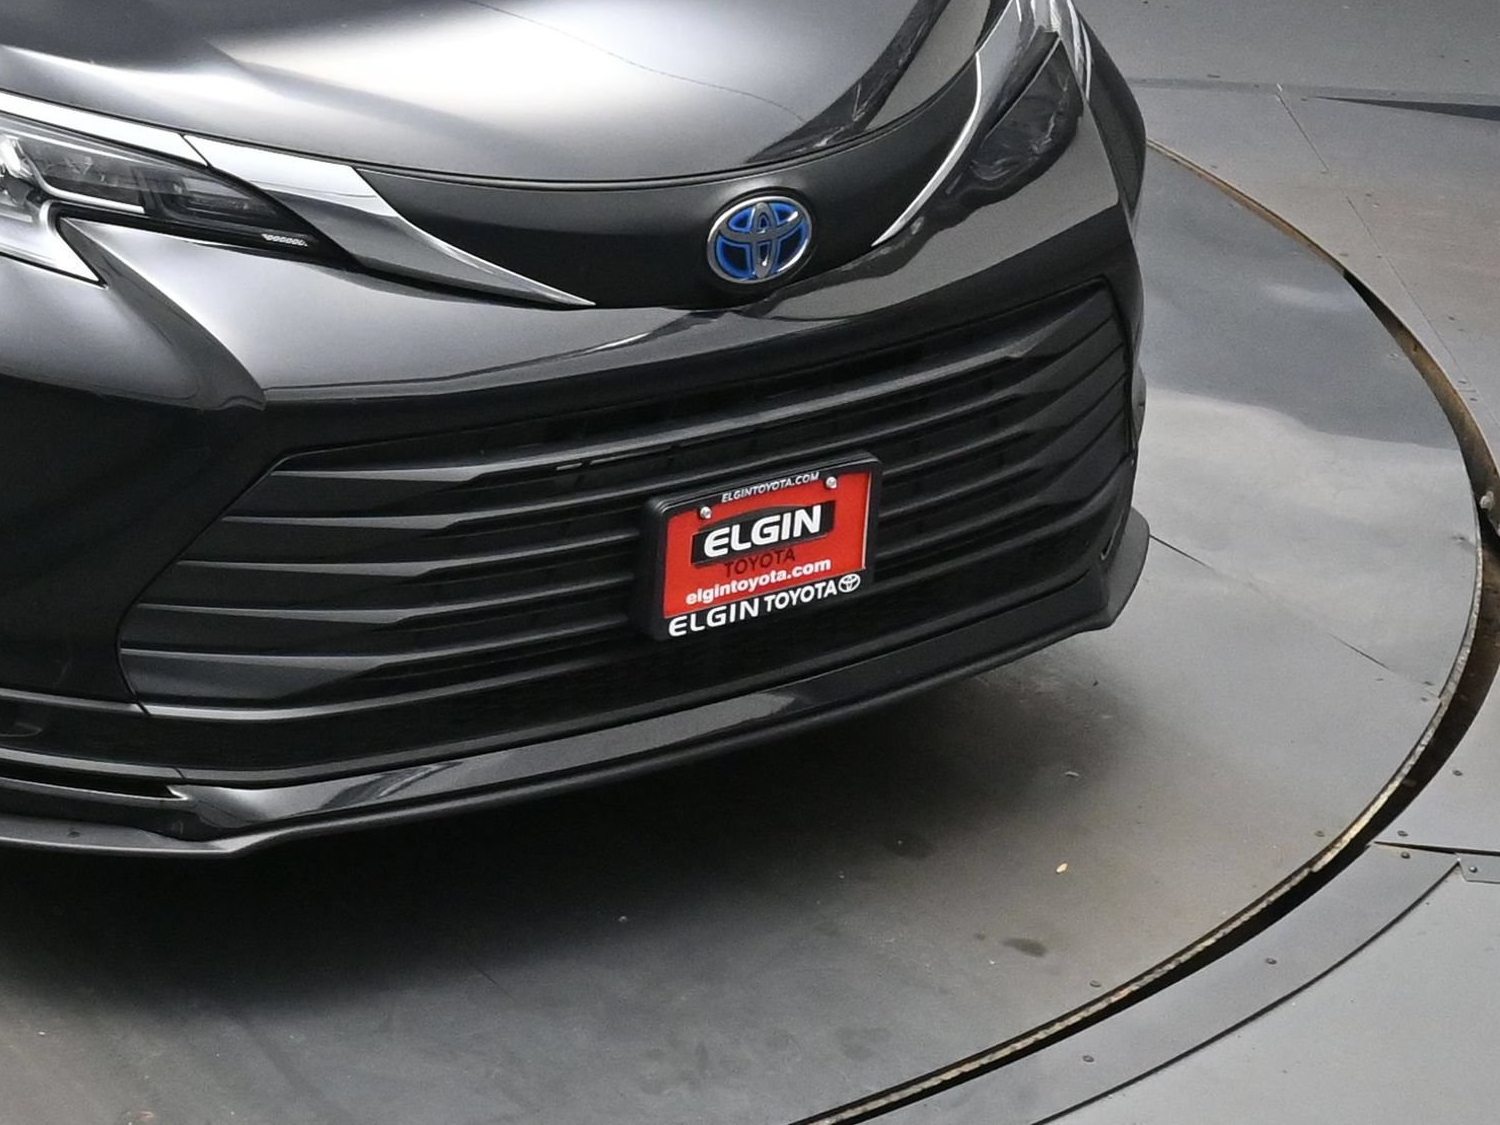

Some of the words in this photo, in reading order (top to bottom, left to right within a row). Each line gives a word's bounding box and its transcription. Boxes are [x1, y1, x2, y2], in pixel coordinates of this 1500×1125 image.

[721, 471, 820, 503] ELGINTOYOTA.COM
[703, 504, 822, 558] ELGIN
[685, 559, 831, 606] elgintoyota.com
[723, 547, 796, 578] TOYOTA
[668, 598, 760, 637] ELGIN
[764, 581, 838, 612] TOYOTA
